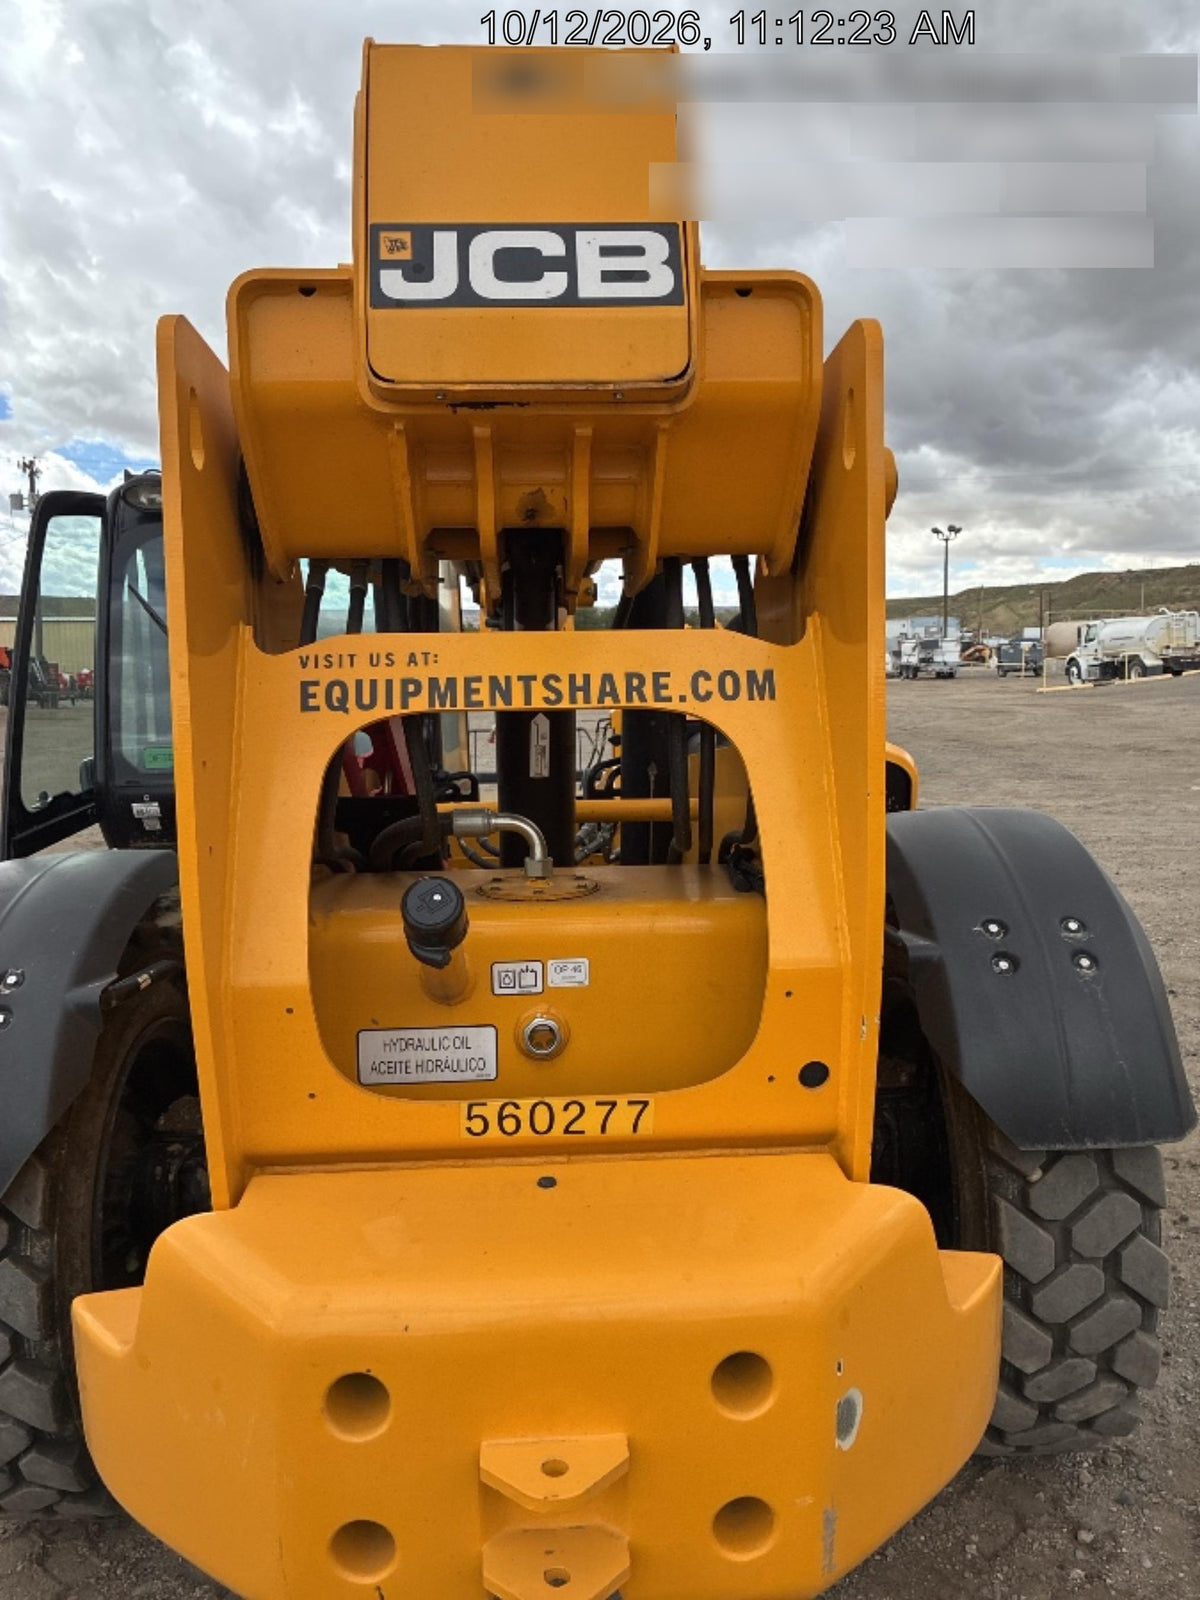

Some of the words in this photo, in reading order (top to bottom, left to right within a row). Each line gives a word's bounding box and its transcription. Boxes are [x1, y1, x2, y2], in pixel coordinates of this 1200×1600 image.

[379, 230, 675, 300] JCB
[299, 653, 357, 669] VISIT
[369, 652, 395, 668] US
[407, 652, 438, 667] AT:
[300, 669, 777, 714] EQUIPMENTSHARE.COM
[384, 1036, 451, 1052] HYDRAULIC
[452, 1036, 472, 1050] OIL
[370, 1059, 413, 1075] ACEITE
[465, 1100, 650, 1137] 560277
